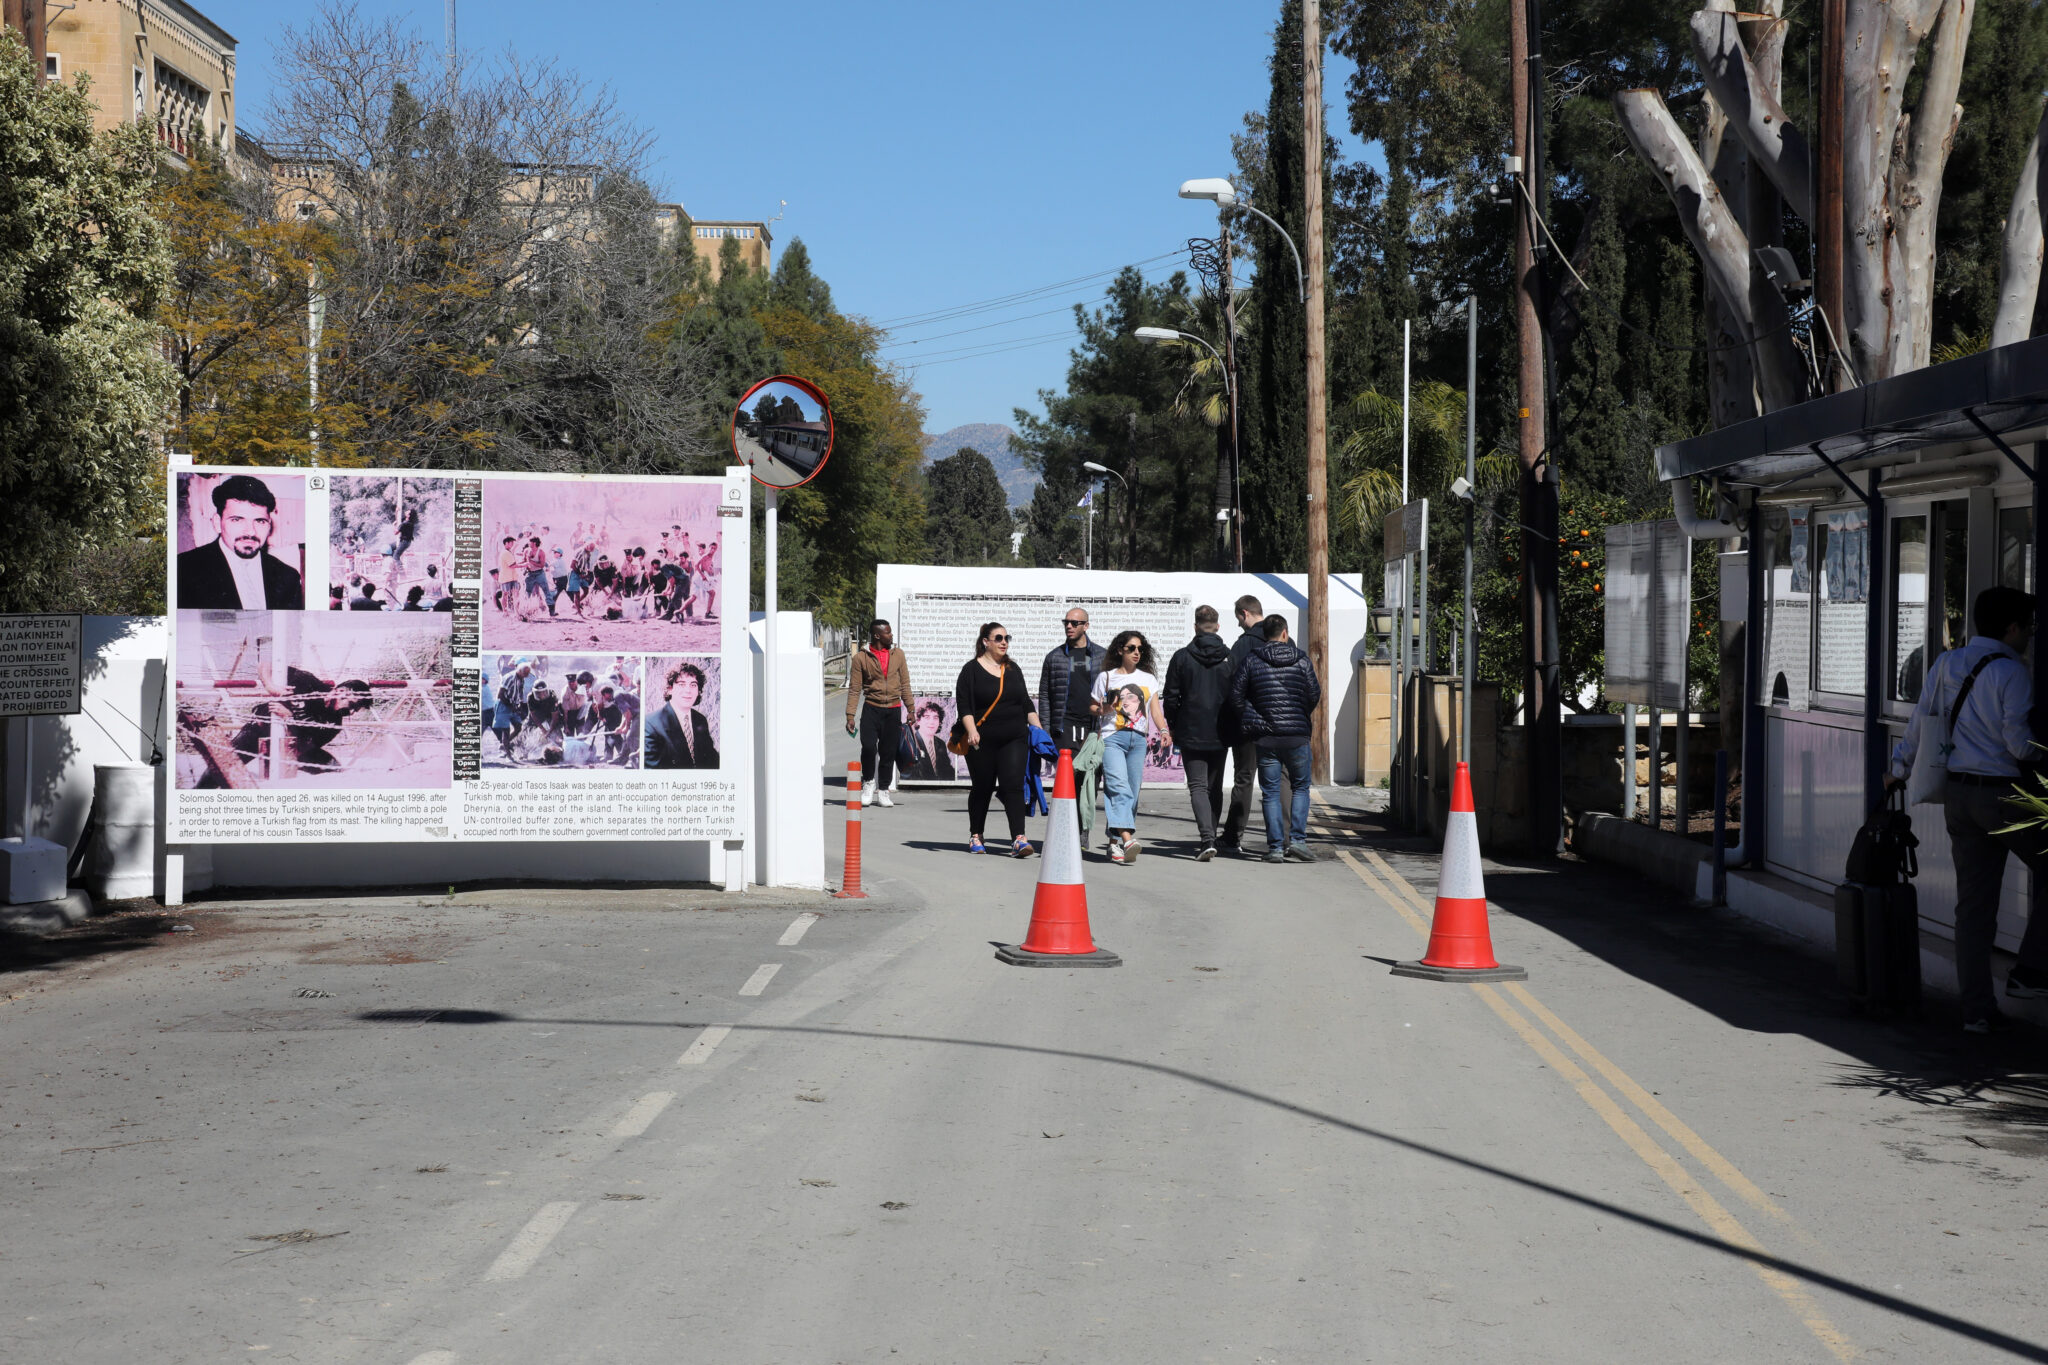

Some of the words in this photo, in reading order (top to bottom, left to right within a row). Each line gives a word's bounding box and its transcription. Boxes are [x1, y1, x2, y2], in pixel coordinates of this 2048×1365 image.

[6, 632, 63, 640] ΔΙΑΚΙΝΗΣΗ
[0, 643, 17, 651] ΩΝ
[47, 642, 74, 650] ΕΙΝΑΙ
[0, 653, 66, 662] ΠΟΜΙΜΗΣΕΙΣ
[14, 668, 69, 677] CROSSING
[0, 679, 75, 689] COUNTERFEIT/
[34, 690, 72, 699] GOODS
[3, 701, 67, 711] PROHIBITED
[464, 780, 478, 789] The
[480, 781, 522, 791] 25-year-old
[525, 781, 547, 789] Tasos
[549, 781, 568, 789] Isaak
[625, 781, 646, 789] death
[671, 781, 697, 791] August
[700, 781, 717, 789] 1996
[719, 782, 728, 791] by
[179, 793, 214, 802] Solomos
[256, 794, 274, 802] then
[276, 794, 296, 804] aged
[377, 793, 404, 803] August
[429, 793, 446, 801] after
[464, 792, 492, 800] Turkish
[541, 793, 564, 803] taking
[567, 793, 582, 802] part
[608, 793, 667, 801] anti-occupation
[179, 806, 201, 816] being
[203, 805, 221, 814] shot
[245, 805, 267, 813] times
[269, 805, 279, 815] by
[281, 805, 310, 813] Turkish
[345, 805, 364, 813] while
[367, 806, 388, 815] trying
[400, 805, 421, 813] climb
[430, 805, 447, 814] pole
[521, 804, 534, 812] the
[558, 804, 566, 812] of
[570, 804, 583, 812] the
[618, 804, 632, 812] The
[636, 804, 660, 814] killing
[686, 804, 707, 813] place
[179, 817, 186, 825] in
[188, 817, 209, 825] order
[261, 816, 290, 825] Turkish
[292, 816, 306, 827] flag
[309, 816, 326, 824] from
[363, 816, 378, 824] The
[380, 816, 402, 826] killing
[404, 816, 443, 827] happened
[463, 816, 521, 824] UN-controlled
[525, 816, 549, 824] buffer
[579, 816, 603, 824] which
[607, 817, 646, 825] separates
[650, 815, 663, 824] the
[667, 816, 701, 824] northern
[705, 815, 734, 824] Turkish
[178, 829, 196, 837] after
[198, 828, 211, 837] the
[213, 828, 240, 836] funeral
[242, 828, 250, 836] of
[295, 827, 322, 836] Tassos
[463, 827, 497, 836] occupied
[499, 827, 518, 835] north
[520, 827, 536, 835] from
[552, 827, 583, 835] southern
[586, 828, 628, 837] government
[667, 828, 681, 836] part
[683, 827, 690, 835] of
